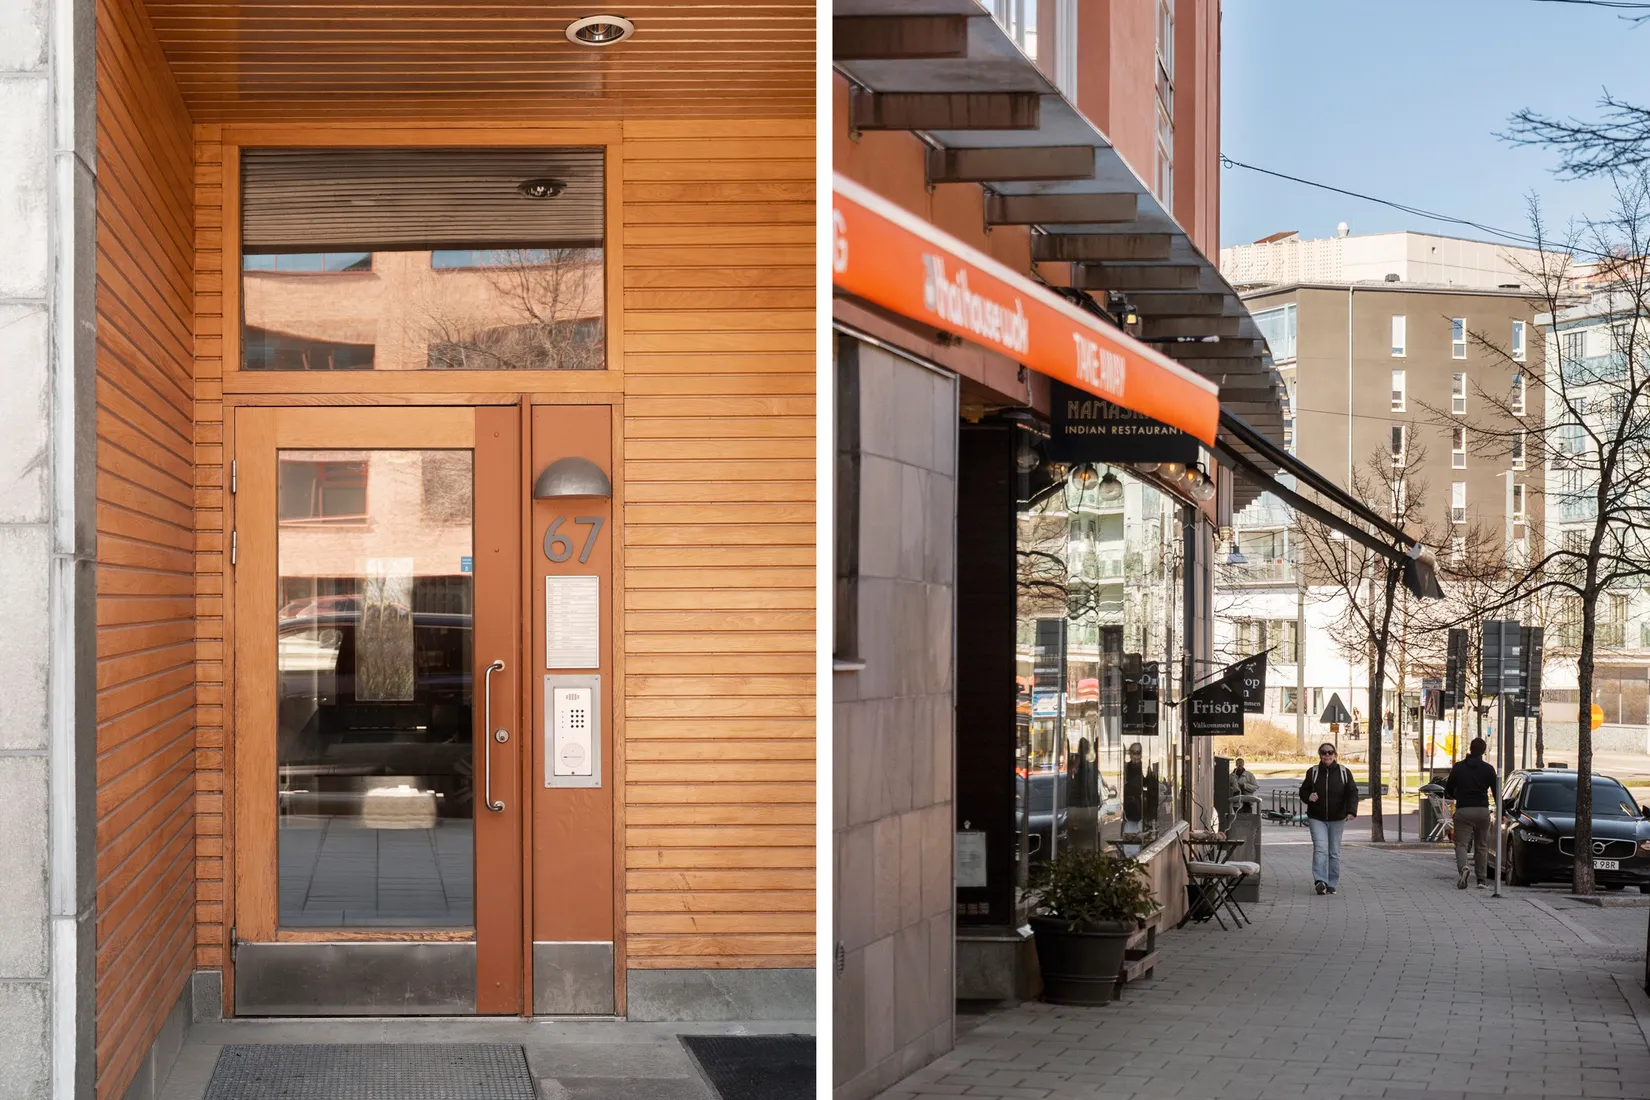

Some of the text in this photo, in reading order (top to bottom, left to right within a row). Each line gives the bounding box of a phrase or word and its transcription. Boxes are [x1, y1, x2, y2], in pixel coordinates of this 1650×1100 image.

[1065, 425, 1106, 435] INDIAN
[543, 515, 605, 564] 67
[1243, 678, 1260, 689] op
[1192, 700, 1240, 714] Frisör
[1232, 721, 1240, 729] in
[1600, 861, 1616, 869] 98R
